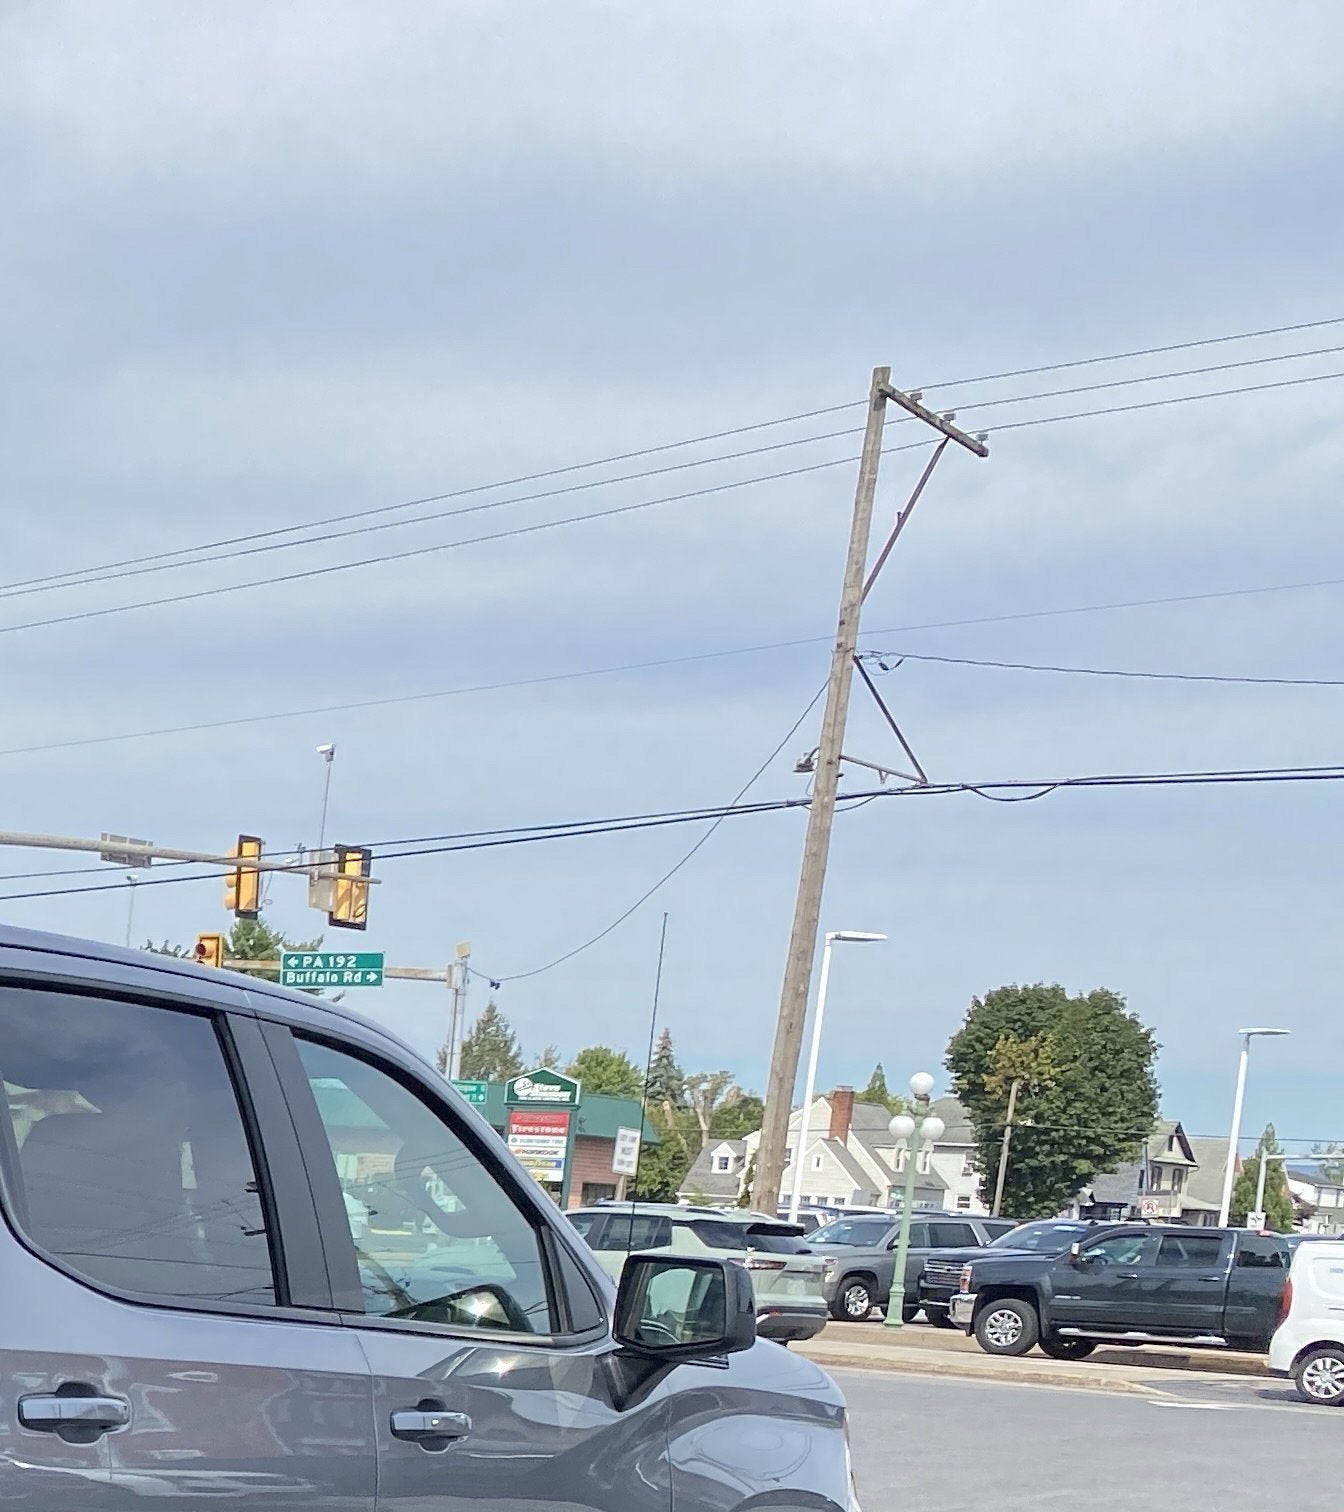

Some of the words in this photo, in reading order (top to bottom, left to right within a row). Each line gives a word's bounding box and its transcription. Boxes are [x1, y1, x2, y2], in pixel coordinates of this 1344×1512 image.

[302, 955, 324, 968] PA
[328, 955, 357, 968] 192
[286, 971, 339, 983] Buffalo
[342, 971, 362, 983] Rd
[512, 1124, 566, 1134] Firestone
